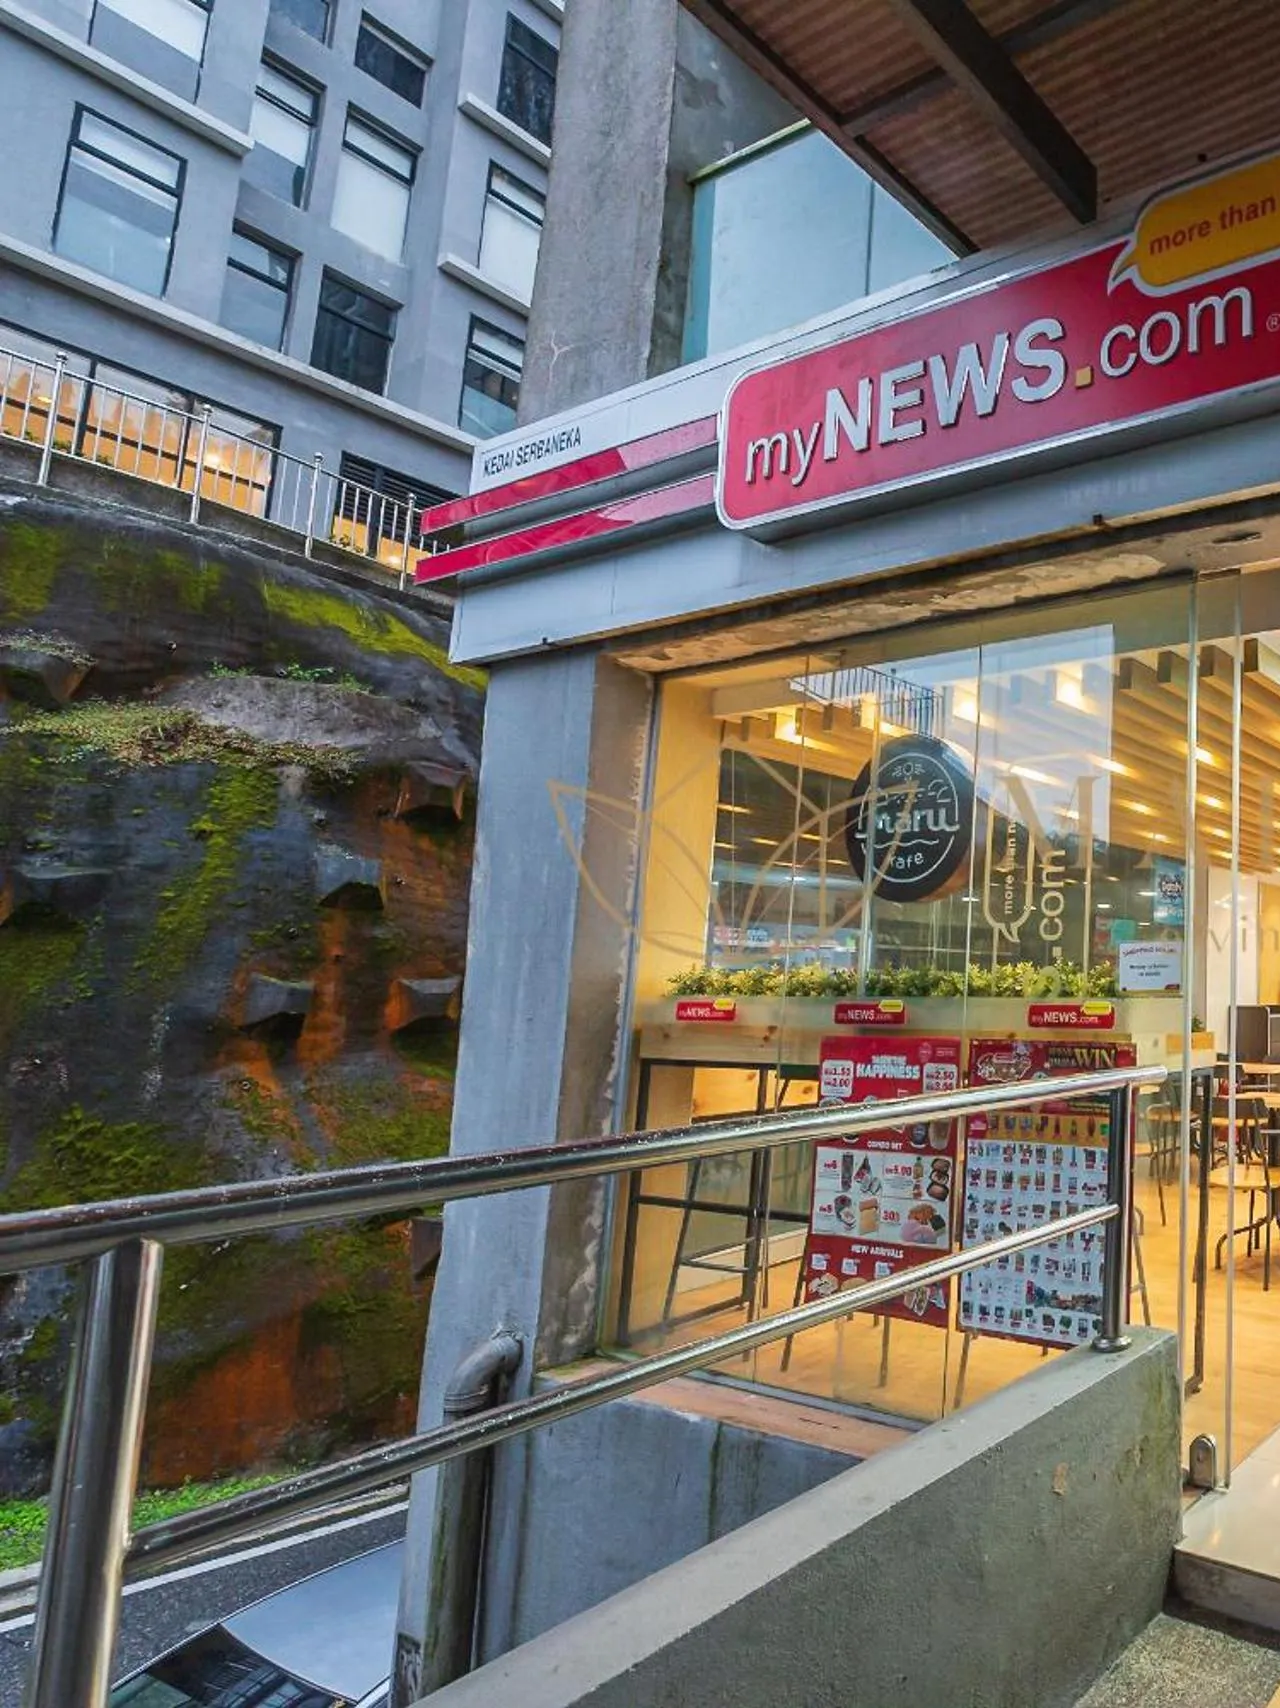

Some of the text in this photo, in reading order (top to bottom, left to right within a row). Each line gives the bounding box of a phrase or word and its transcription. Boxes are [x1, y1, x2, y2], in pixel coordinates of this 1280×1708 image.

[1149, 219, 1211, 255] more
[1218, 196, 1276, 231] than
[745, 286, 1254, 487] myNEWS.com
[484, 426, 581, 477] KEDAI SERBANEKA
[856, 1063, 921, 1079] HAPPINESS
[1074, 1047, 1117, 1069] WIN
